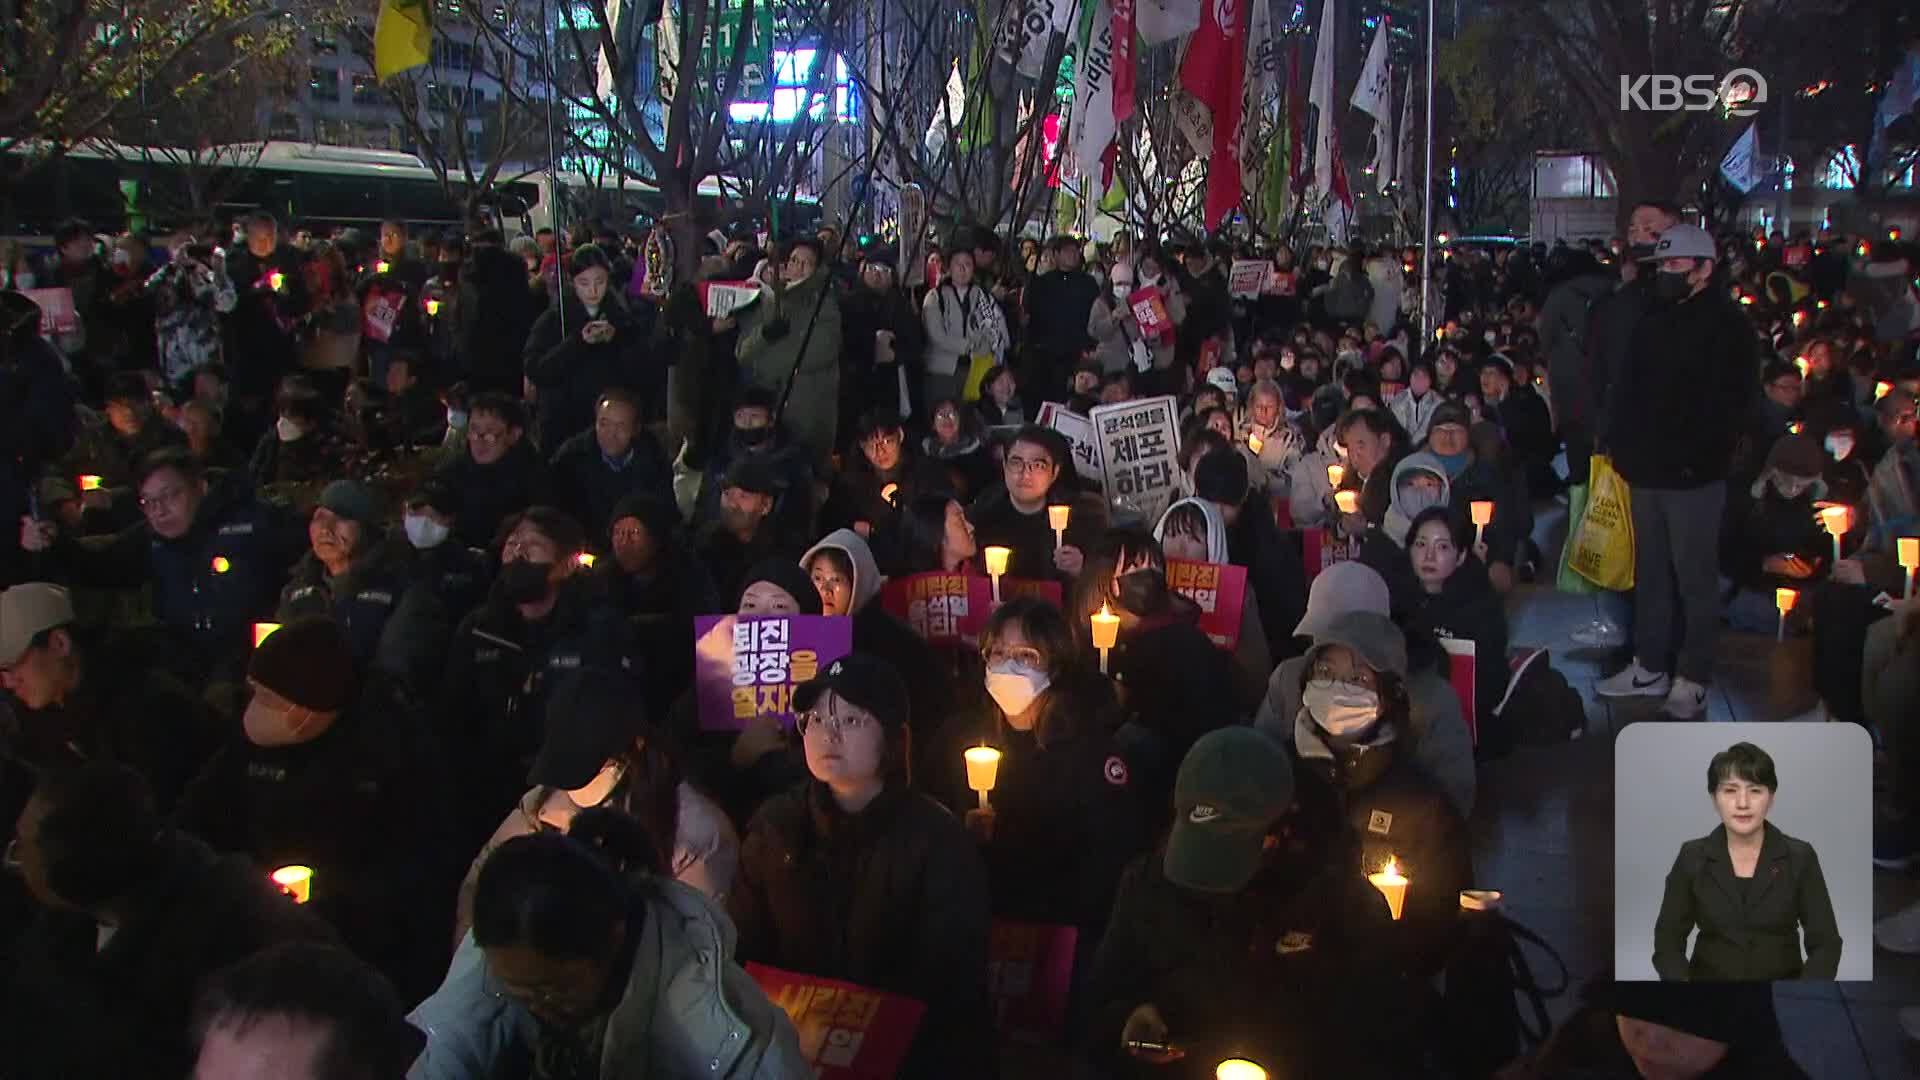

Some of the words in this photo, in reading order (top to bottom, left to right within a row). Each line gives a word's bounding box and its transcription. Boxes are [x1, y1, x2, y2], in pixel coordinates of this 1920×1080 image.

[1110, 429, 1168, 464] 체포
[1114, 460, 1173, 495] 하라
[733, 619, 789, 652] 퇴진
[732, 649, 818, 686] 광장을
